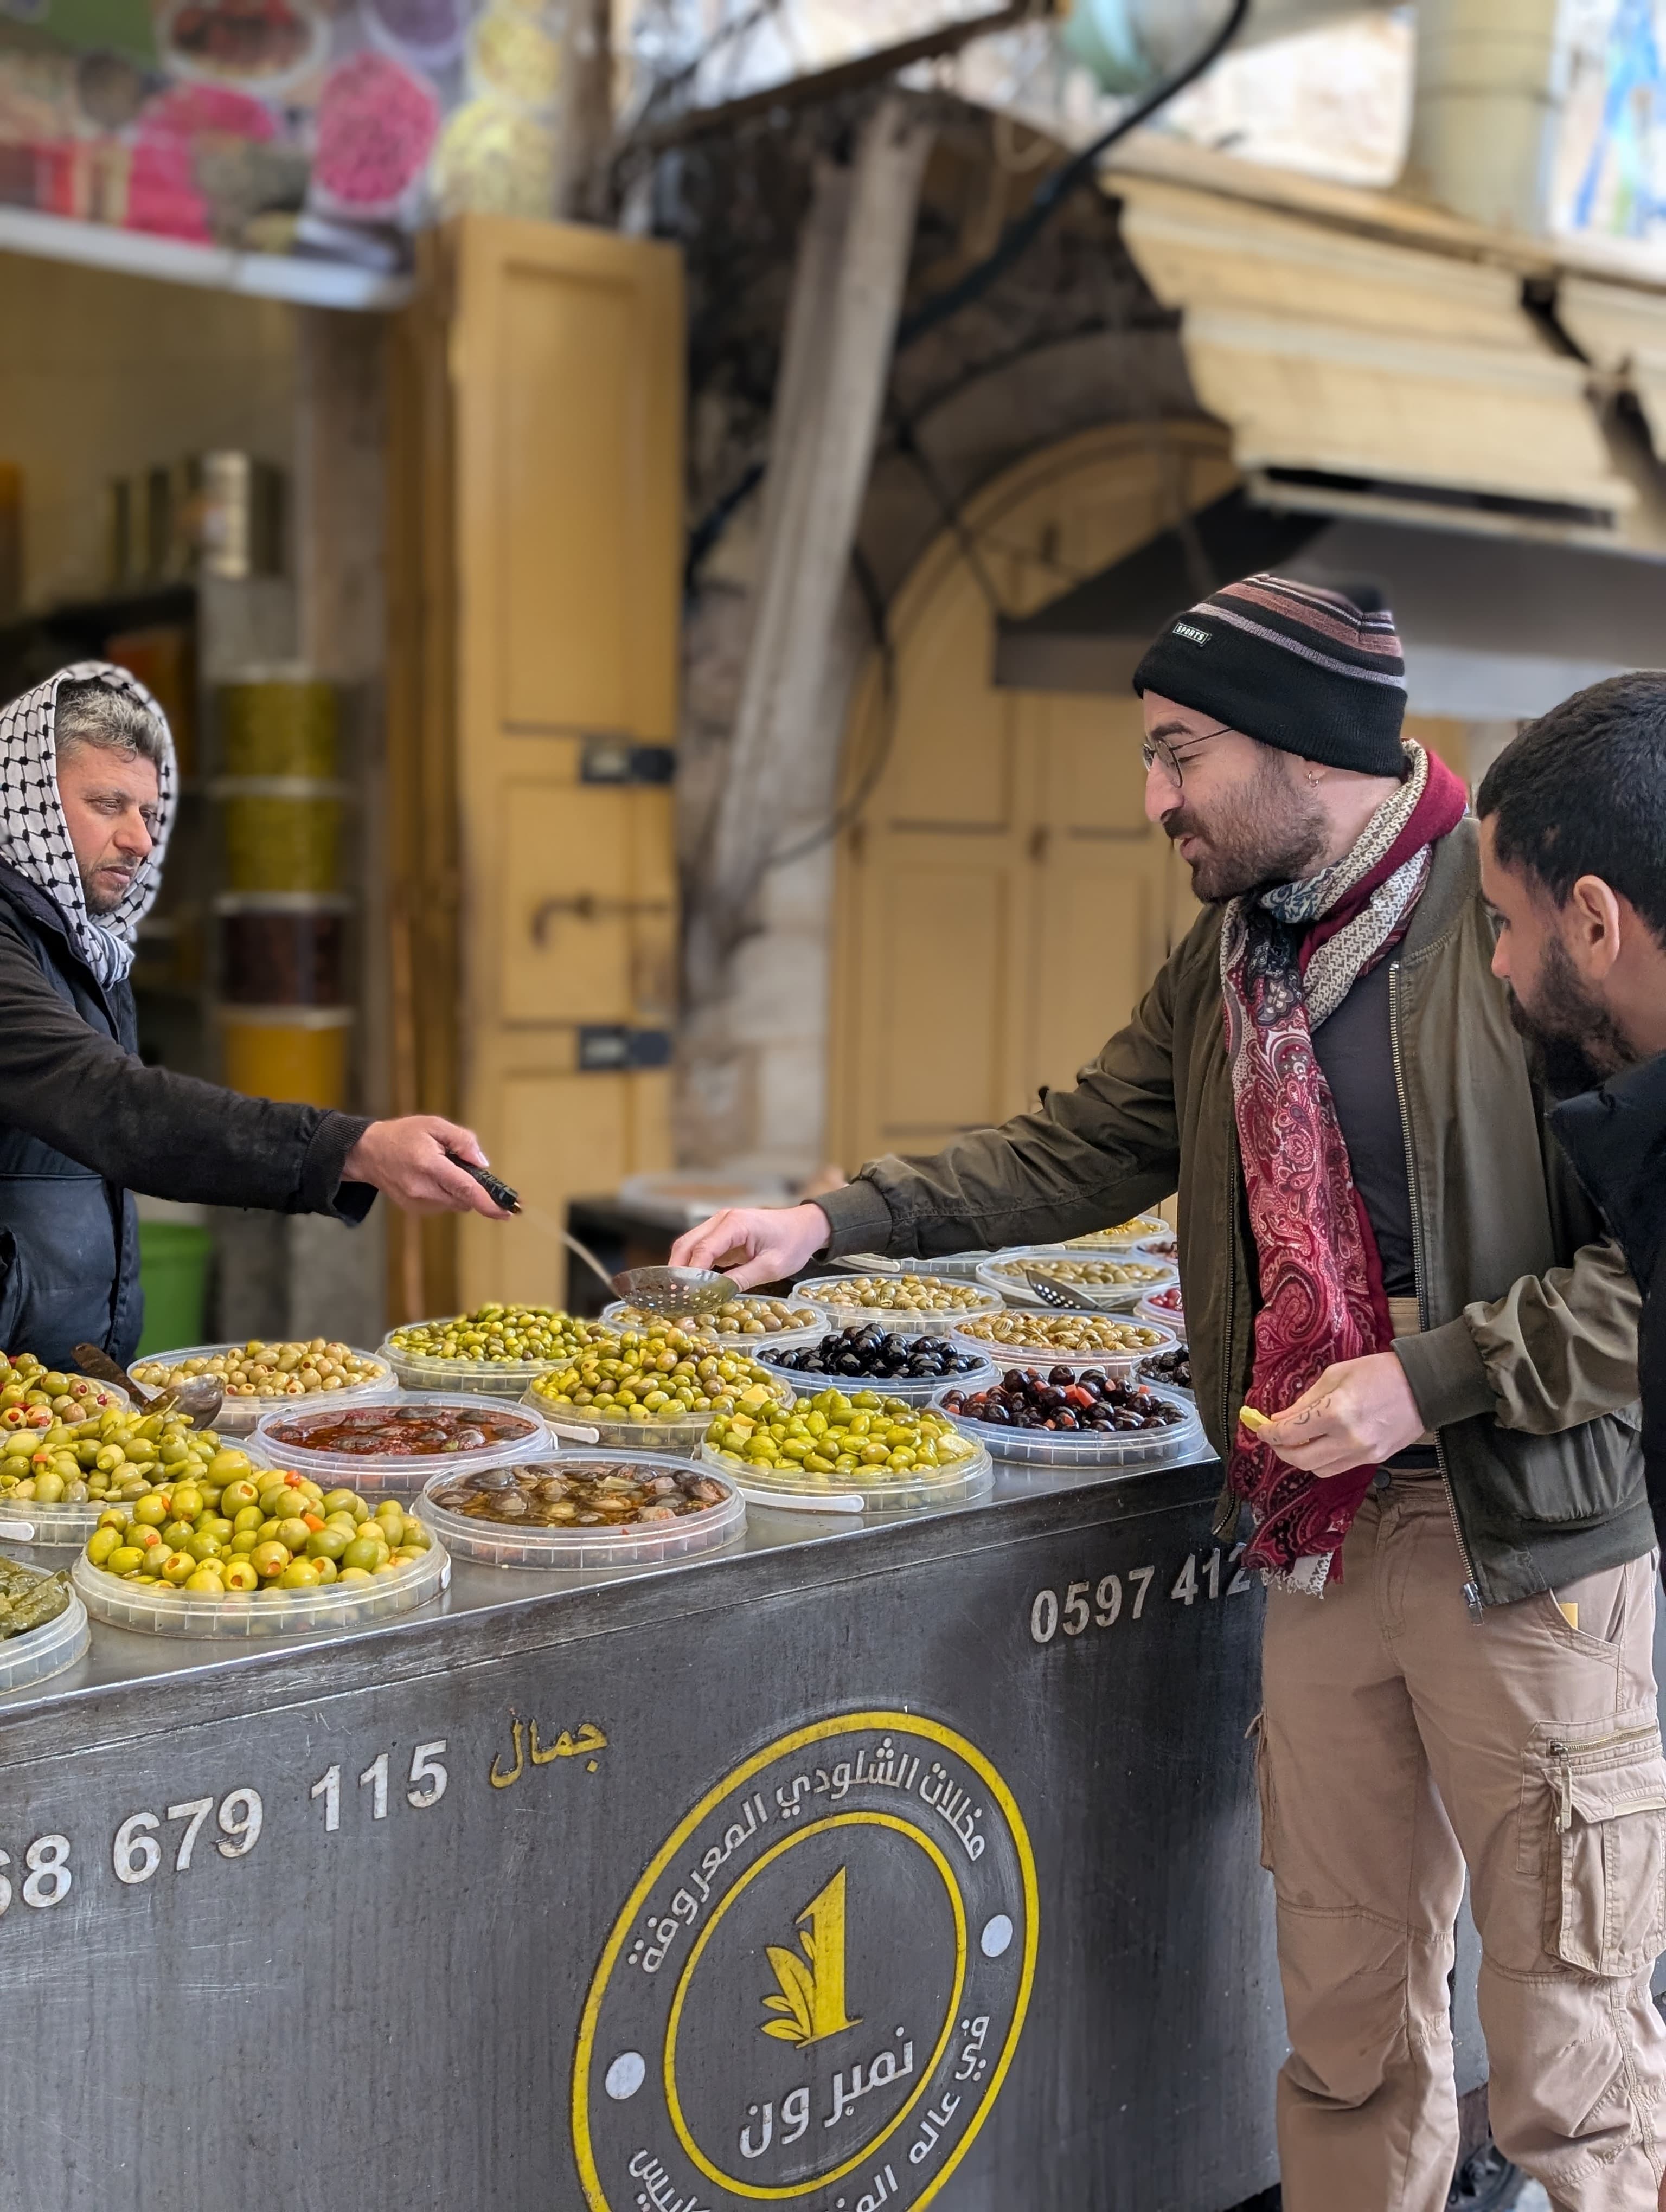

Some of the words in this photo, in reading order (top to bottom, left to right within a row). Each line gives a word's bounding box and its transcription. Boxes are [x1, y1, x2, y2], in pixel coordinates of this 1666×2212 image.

[1176, 625, 1205, 641] SPORTS
[1031, 1565, 1155, 1643] 0597
[490, 1719, 608, 1789] جمال
[776, 1737, 920, 1819] الشلودي
[0, 1834, 72, 1917] 8
[112, 1788, 265, 1884] 679
[311, 1740, 448, 1831] 115
[919, 1762, 985, 1862] مخللات
[628, 1792, 768, 1973] المعروفة
[824, 2026, 913, 2129] نمبر
[954, 2016, 990, 2082] في
[739, 2087, 810, 2159] ون
